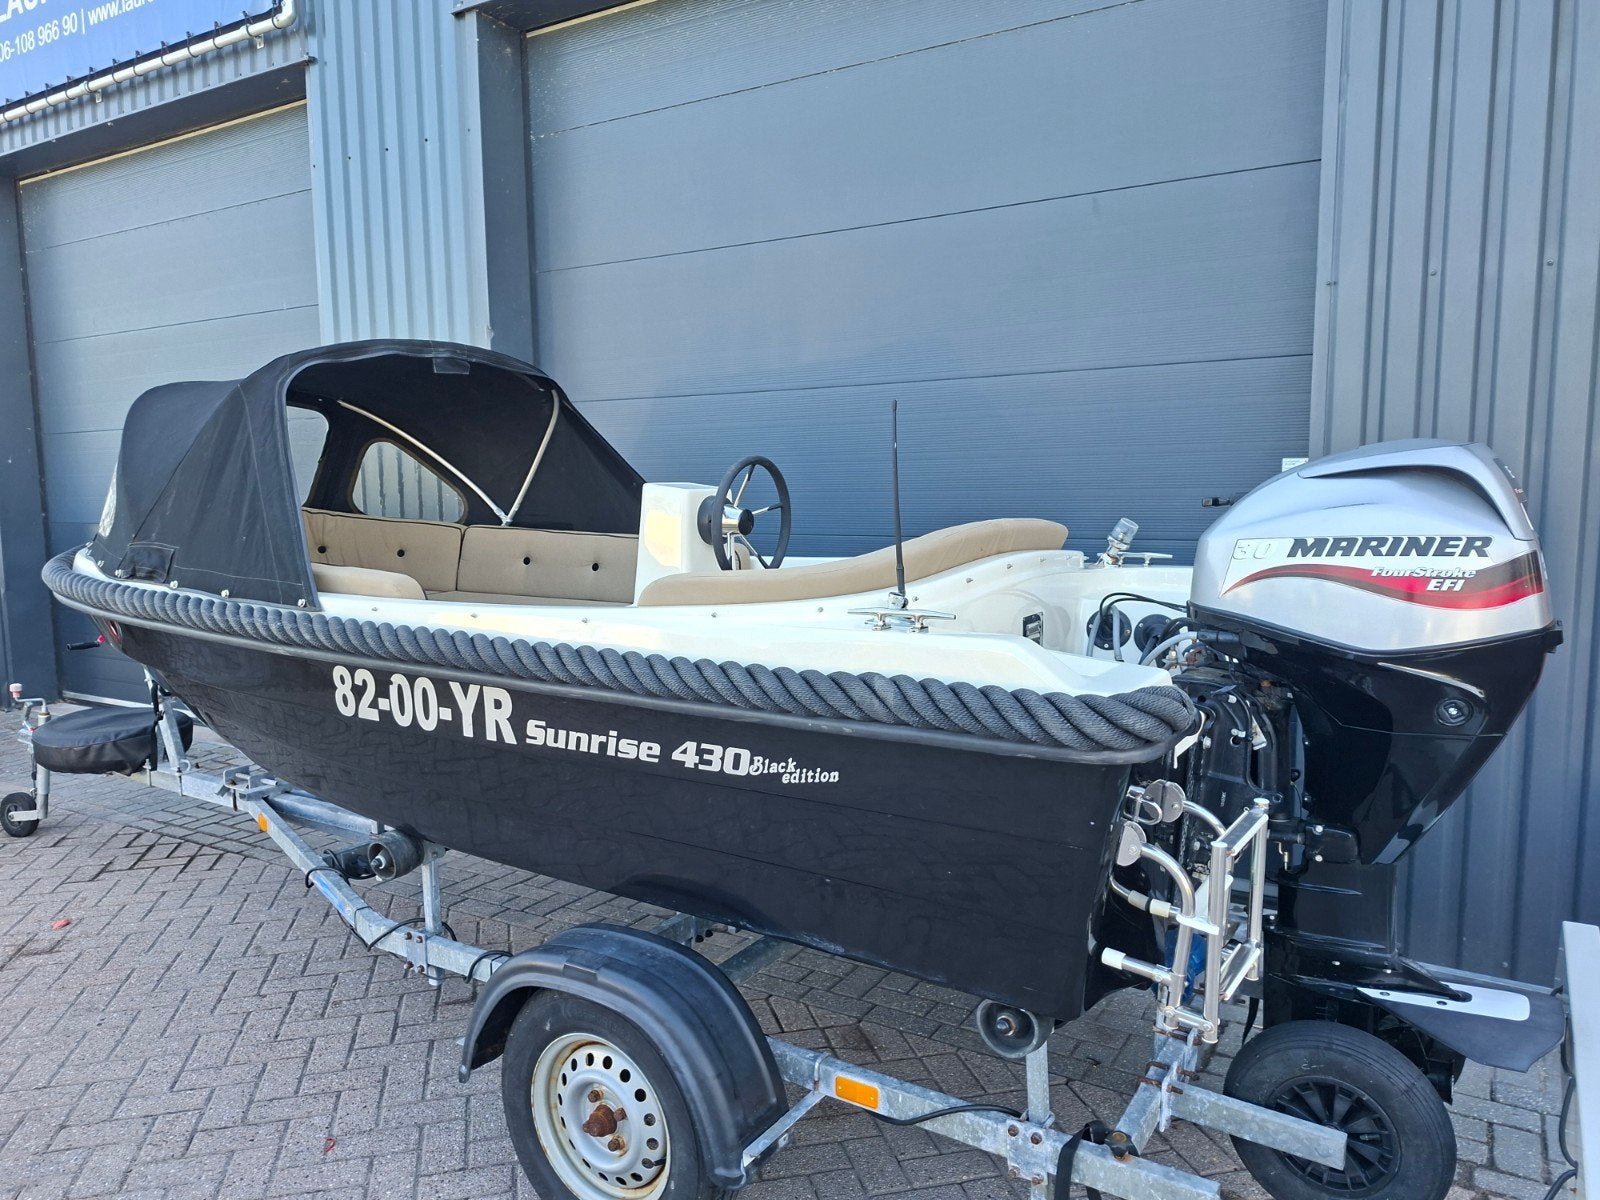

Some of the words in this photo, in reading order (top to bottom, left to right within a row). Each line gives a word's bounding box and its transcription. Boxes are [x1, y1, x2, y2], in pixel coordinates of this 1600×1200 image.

[37, 20, 60, 46] 966
[61, 12, 78, 36] 90
[1287, 536, 1493, 557] MARINER
[1370, 566, 1477, 578] FourStroke
[1426, 578, 1466, 592] EFI
[332, 665, 518, 745] 82-00-YR
[525, 719, 661, 763] Sunrise
[671, 740, 751, 776] 430
[749, 755, 797, 776] Black
[781, 767, 840, 784] edition
